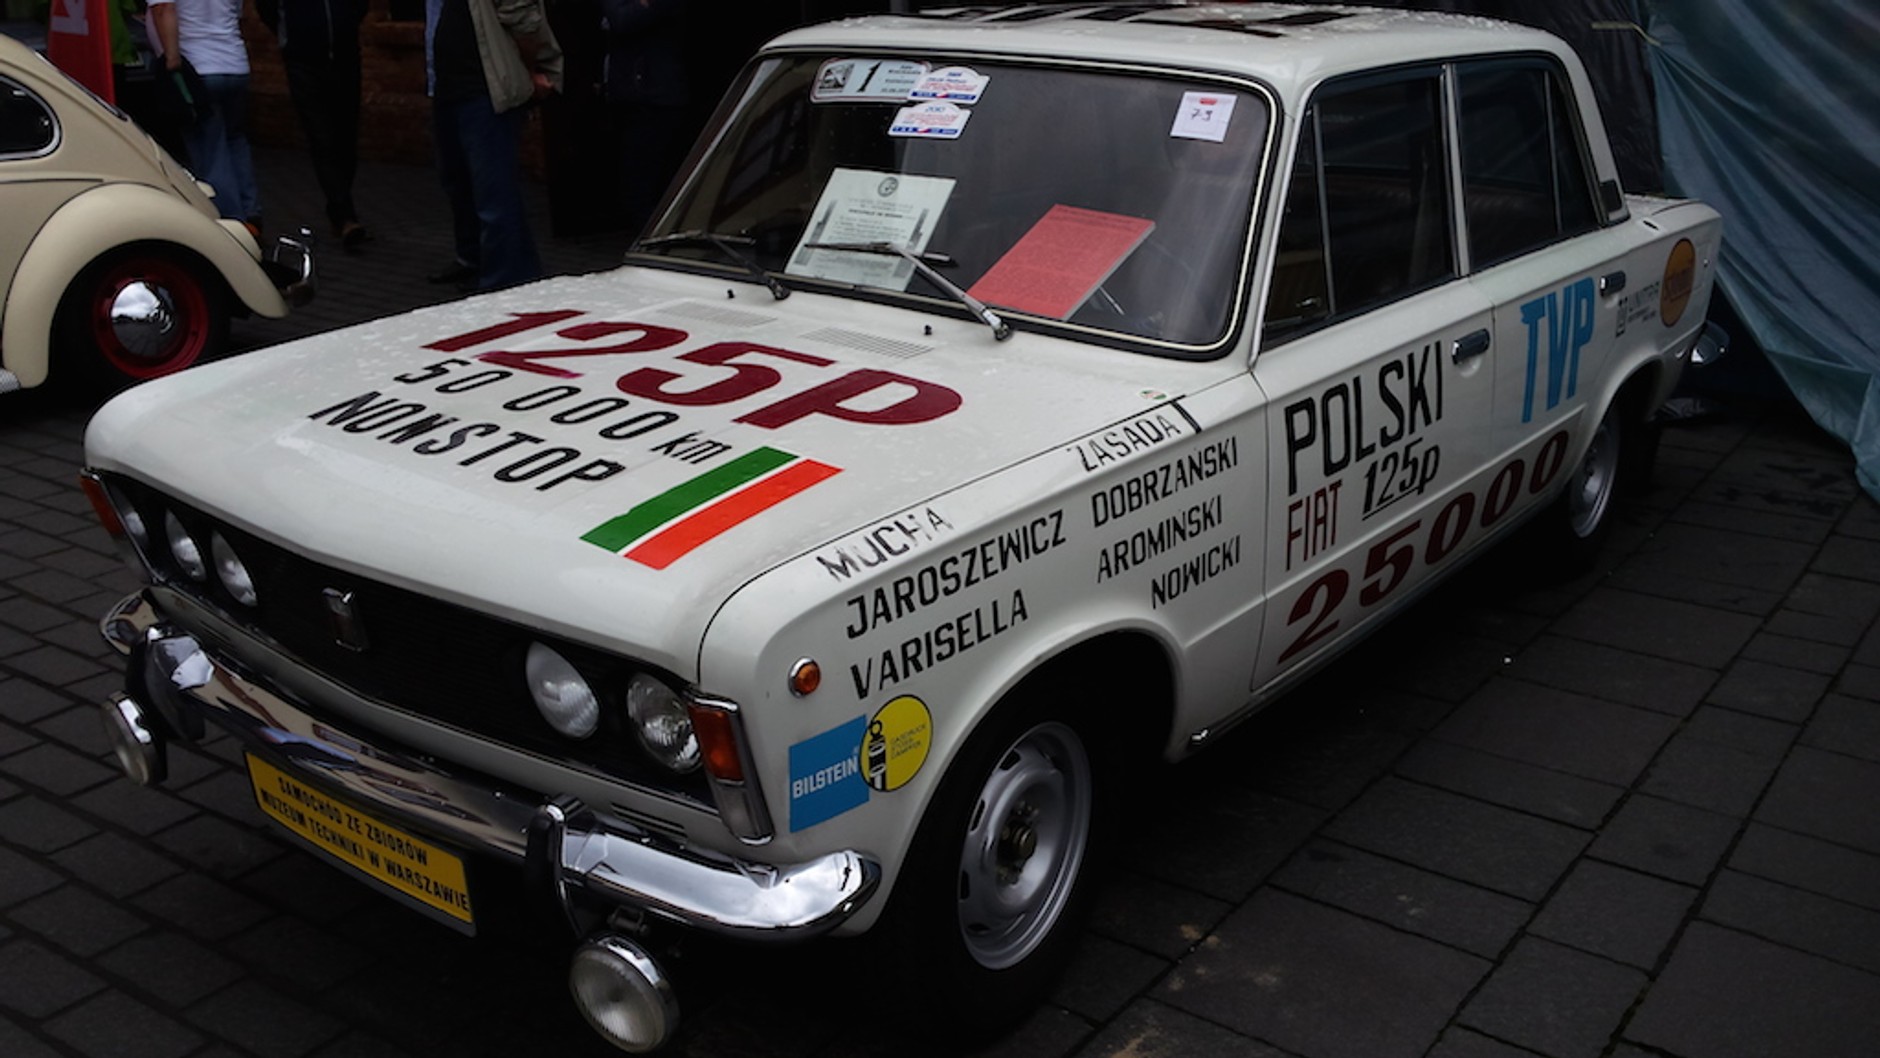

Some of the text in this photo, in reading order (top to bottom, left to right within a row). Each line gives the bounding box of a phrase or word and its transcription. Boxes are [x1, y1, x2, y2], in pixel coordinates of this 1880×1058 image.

[856, 61, 882, 93] 1
[1520, 277, 1594, 424] TVP
[308, 391, 625, 491] NONSTOP
[650, 430, 732, 465] km
[1066, 414, 1182, 472] ZASADA
[1284, 340, 1442, 496] POLSKI
[816, 507, 954, 582] MUCHA
[1278, 430, 1570, 664] 25000
[1286, 437, 1440, 571] FIAT 125p
[846, 509, 1067, 640] JAROSZEWICZ
[1151, 535, 1241, 610] NOWICKI
[850, 588, 1029, 700] VARISELLA
[791, 753, 860, 800] BILSTEIN
[260, 789, 470, 912] MUZEUM TECHNIKI W WARSZAWIE
[346, 814, 362, 835] ZE
[363, 821, 428, 867] ZBIORÓW
